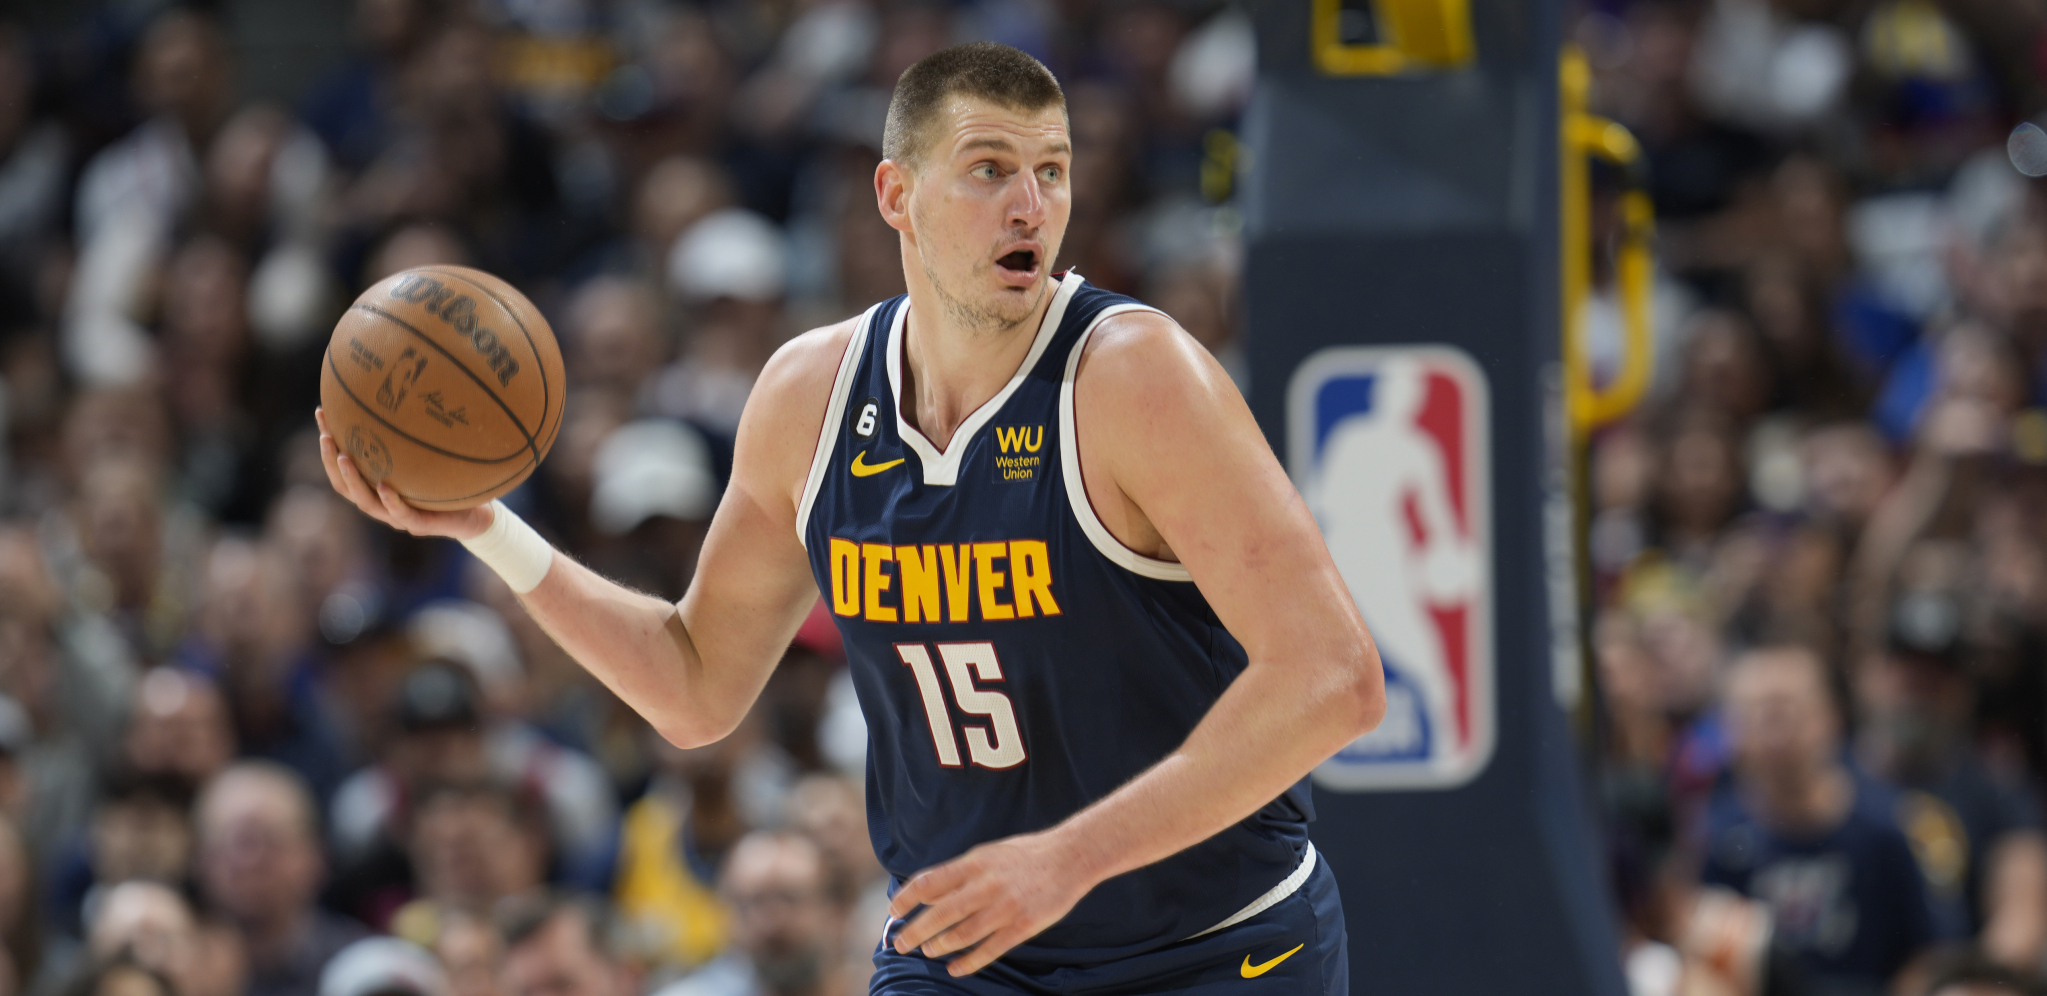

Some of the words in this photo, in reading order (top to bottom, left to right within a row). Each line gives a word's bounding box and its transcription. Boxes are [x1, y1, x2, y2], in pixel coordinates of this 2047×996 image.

[389, 274, 519, 388] Wilson
[856, 403, 877, 436] 6
[996, 425, 1043, 453] WU
[995, 456, 1040, 468] Western
[1003, 467, 1033, 480] Union
[829, 537, 1062, 623] DENVER
[892, 640, 1029, 771] 15
